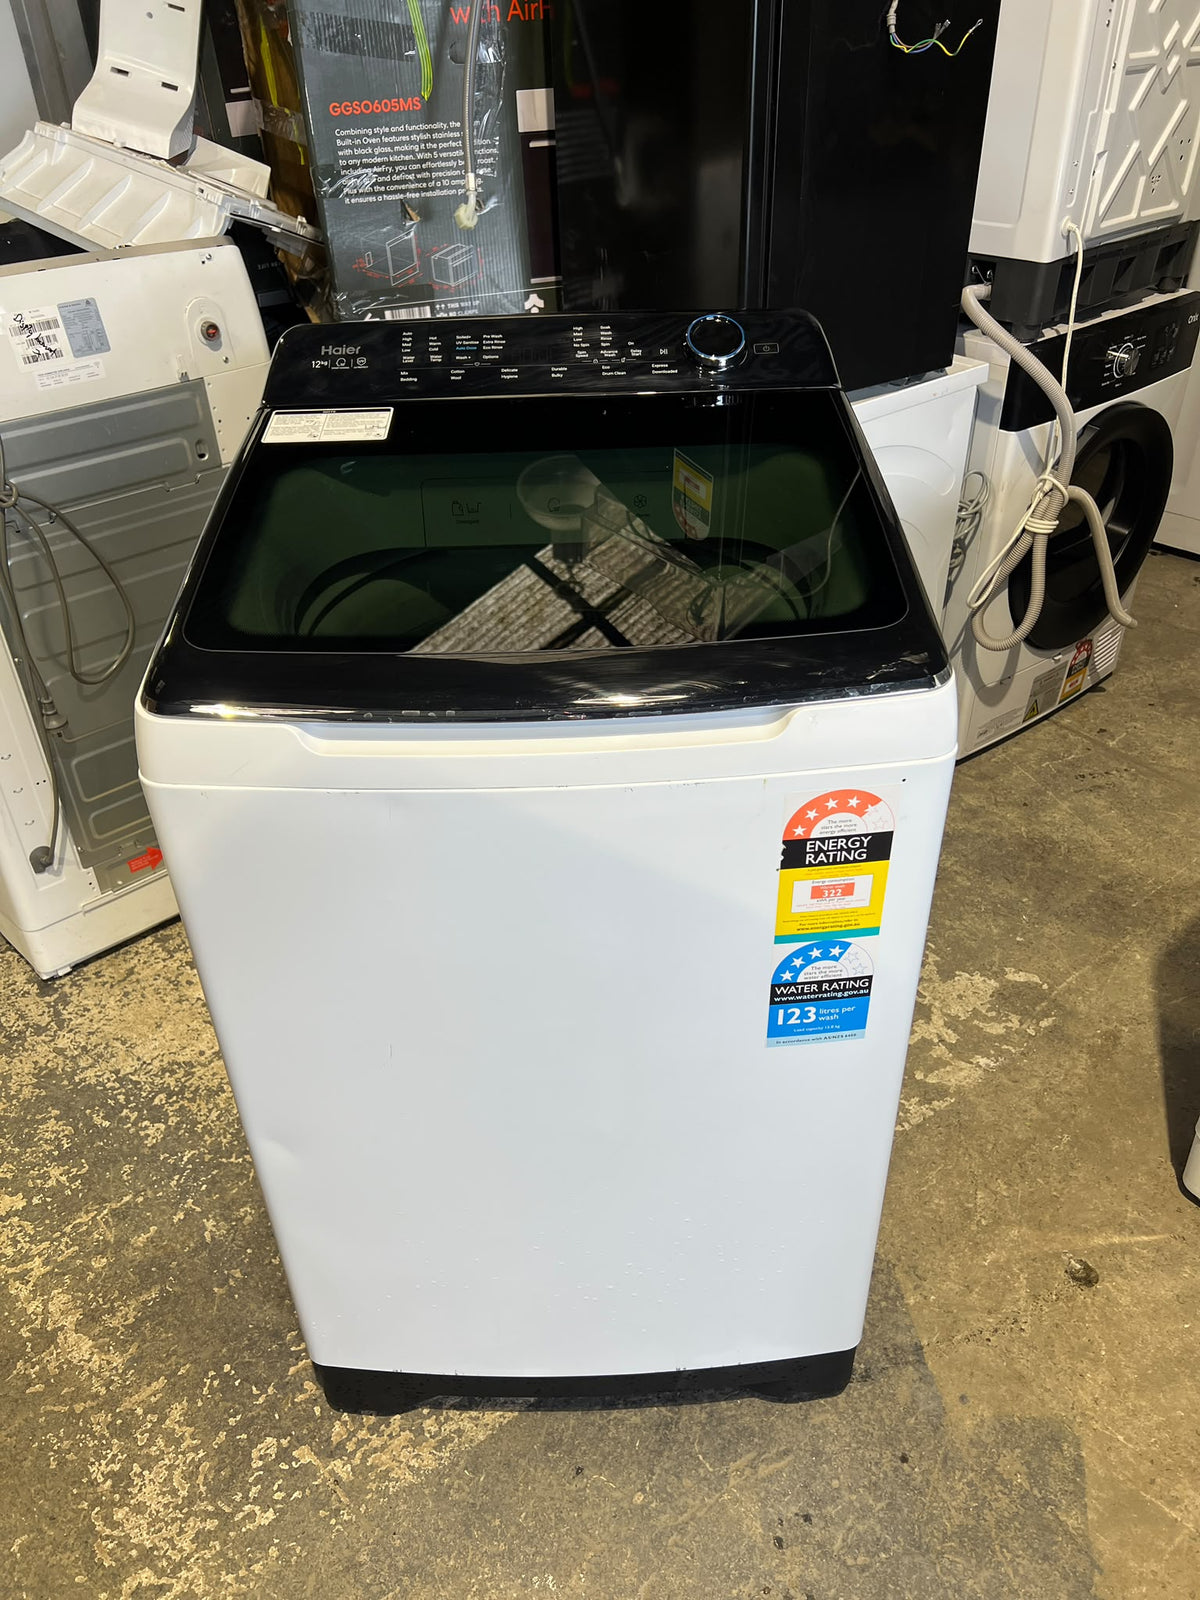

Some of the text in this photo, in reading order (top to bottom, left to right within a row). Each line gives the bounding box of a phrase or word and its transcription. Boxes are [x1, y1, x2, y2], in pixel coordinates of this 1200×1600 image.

[329, 97, 422, 116] GGSO605MS
[335, 128, 372, 136] Combining
[373, 126, 389, 134] style
[405, 122, 448, 131] functionality,
[336, 138, 361, 146] Built-in
[362, 136, 380, 144] Oven
[382, 134, 410, 143] features
[410, 132, 431, 141] stylish
[432, 130, 460, 139] stainless
[354, 146, 373, 155] black
[394, 144, 419, 152] making
[438, 140, 462, 150] perfect
[362, 156, 388, 164] modern
[416, 152, 432, 160] With
[422, 160, 457, 168] effortlessly
[392, 172, 415, 181] defrost
[432, 169, 460, 178] precision
[386, 182, 427, 191] convenience
[383, 192, 420, 200] hassle-free
[420, 189, 457, 198] installation
[321, 344, 361, 355] Haier
[806, 835, 872, 852] ENERGY
[805, 849, 867, 865] RATING
[822, 889, 842, 898] 322
[775, 978, 869, 995] WATER RATING
[774, 988, 869, 1002] www.waterrating.gov.au
[777, 1006, 817, 1026] 123
[842, 1006, 856, 1014] per
